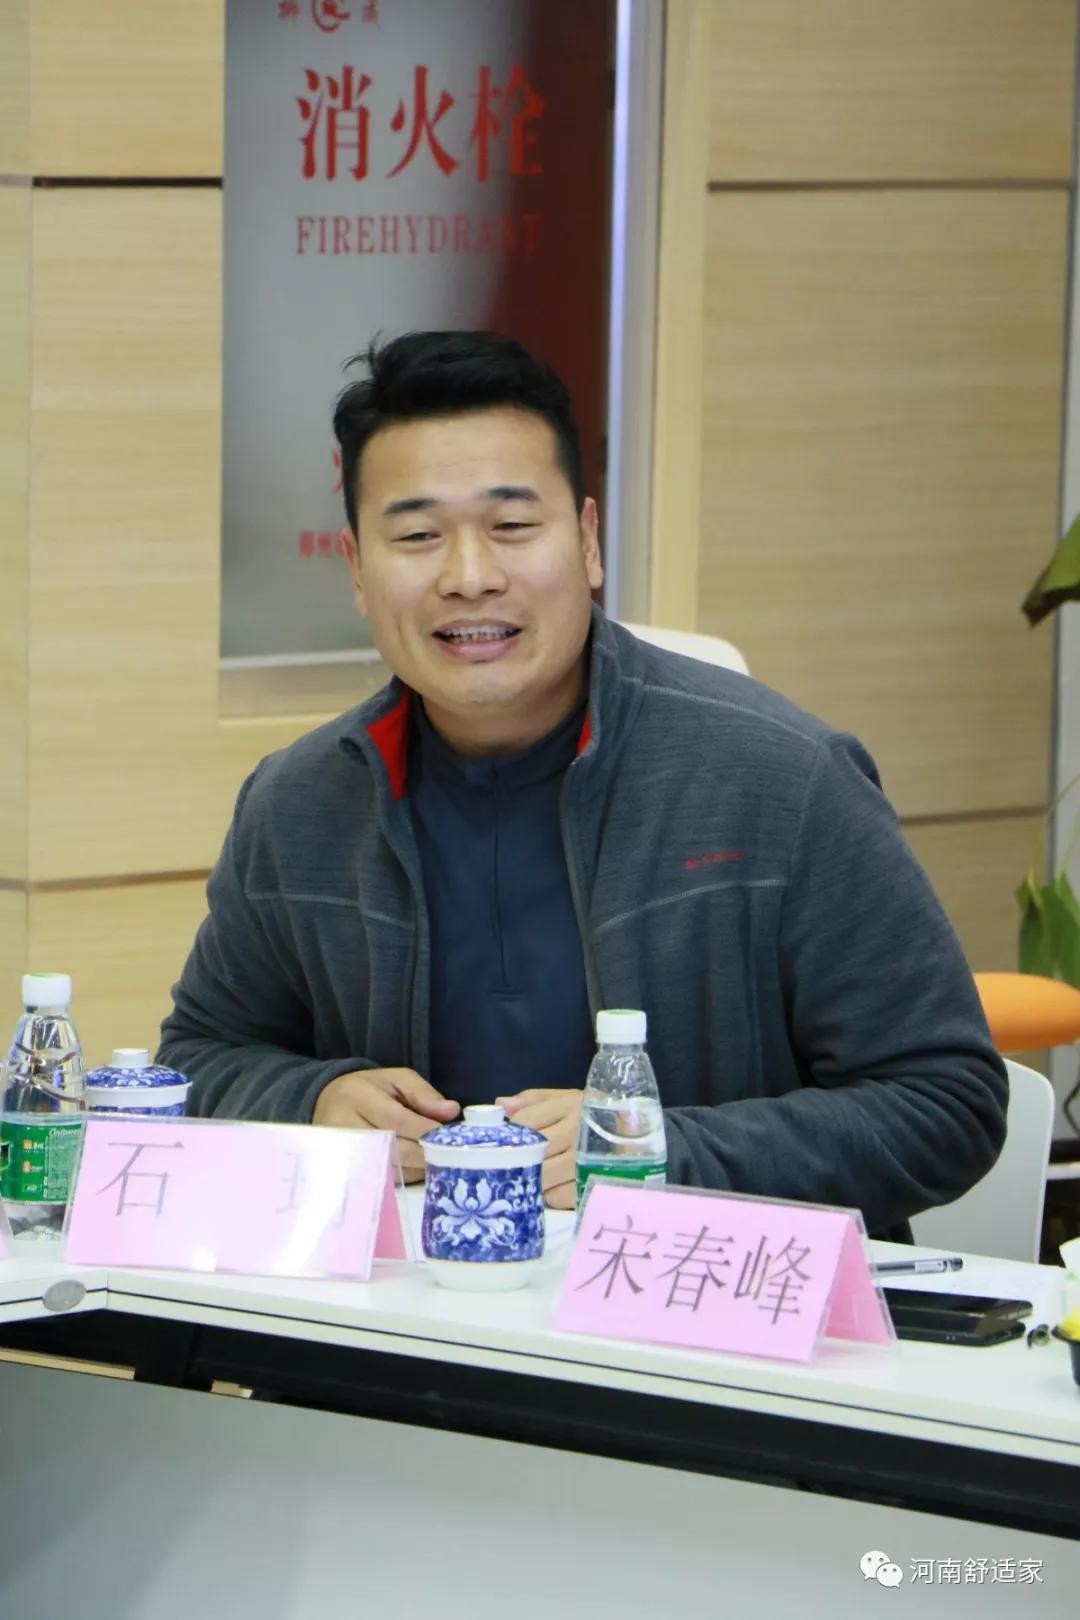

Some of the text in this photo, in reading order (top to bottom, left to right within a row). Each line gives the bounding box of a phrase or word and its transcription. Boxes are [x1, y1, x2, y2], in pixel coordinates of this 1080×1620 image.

[297, 65, 544, 182] 消火栓
[296, 214, 541, 257] FIREHYDRANT
[574, 1214, 812, 1326] 宋春峰
